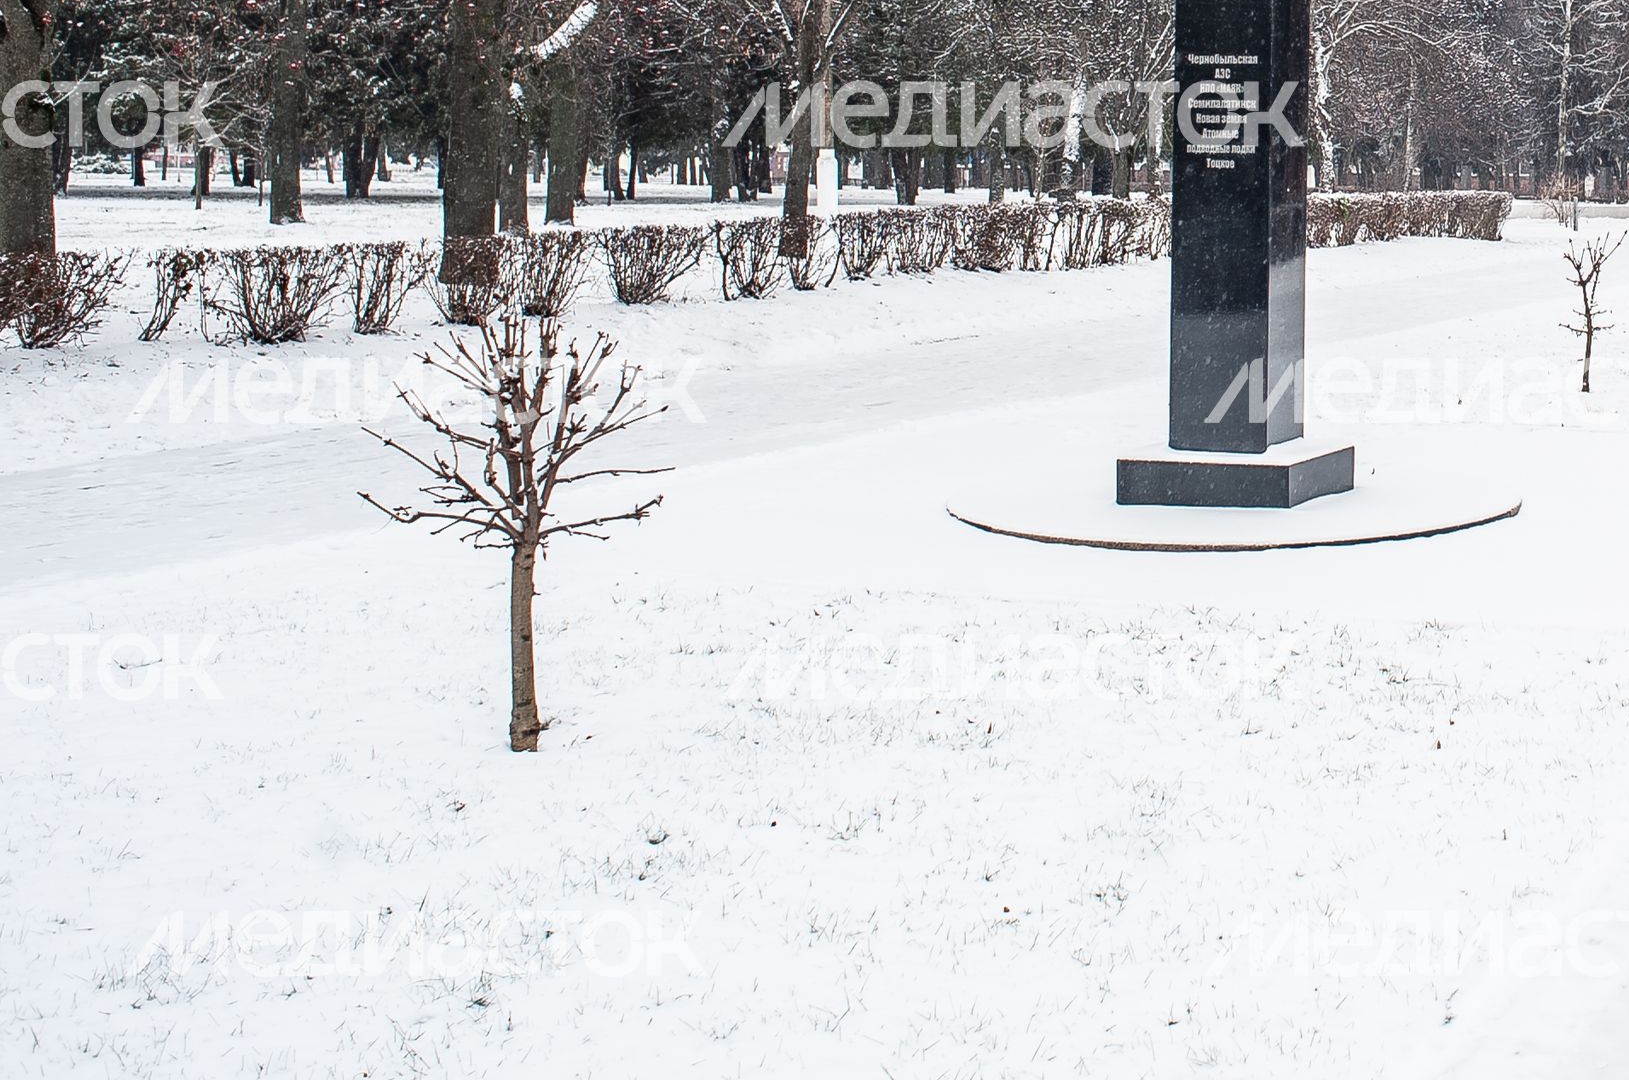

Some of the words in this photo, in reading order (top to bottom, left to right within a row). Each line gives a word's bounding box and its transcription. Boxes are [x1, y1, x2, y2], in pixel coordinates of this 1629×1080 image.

[1187, 54, 1258, 65] Чернобыльская
[1196, 113, 1220, 124] Новая
[1206, 158, 1235, 169] Тоцкое
